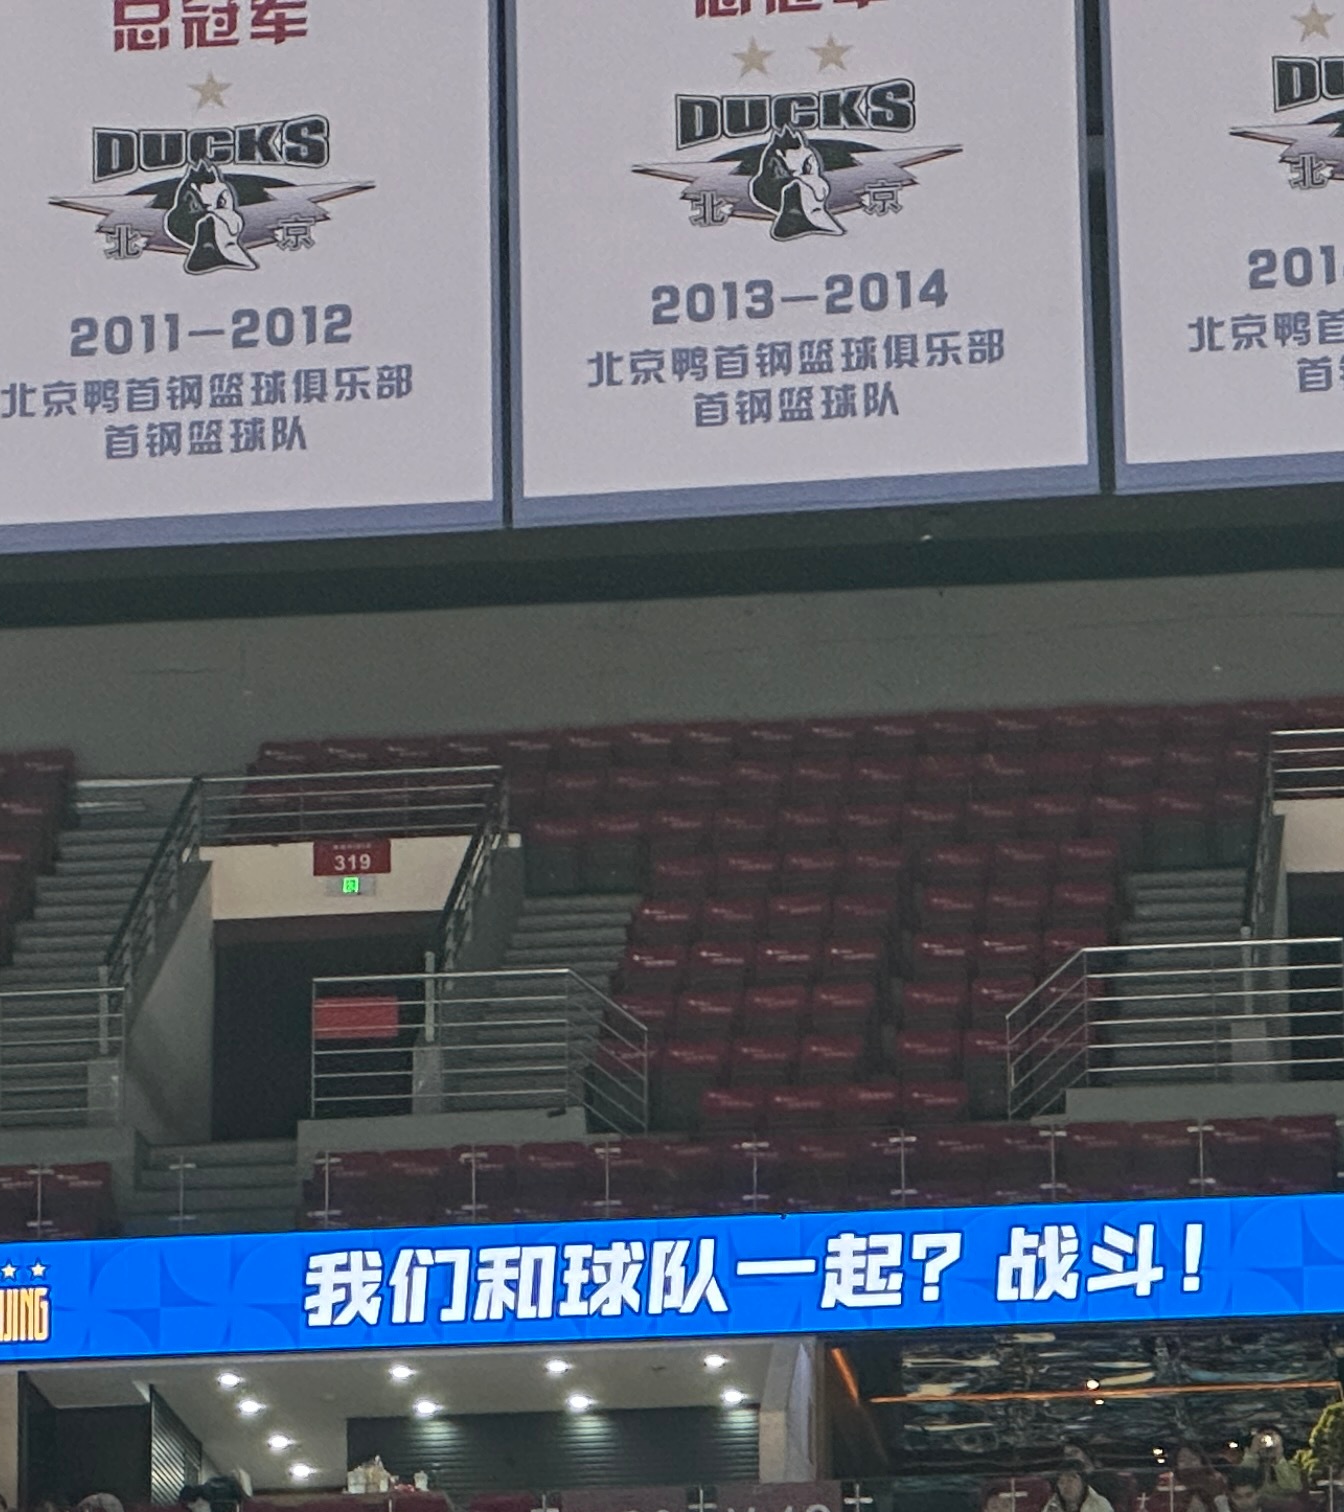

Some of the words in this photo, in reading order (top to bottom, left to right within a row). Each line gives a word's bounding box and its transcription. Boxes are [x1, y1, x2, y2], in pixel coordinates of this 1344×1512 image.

[675, 77, 915, 150] DUCKS
[92, 115, 329, 181] DUCKS
[1289, 153, 1329, 191] 北
[690, 191, 731, 227] 北
[864, 179, 904, 215] 京
[105, 225, 143, 260] 北
[278, 214, 316, 251] 京
[587, 328, 1005, 388] 北京鸭首钢篮球俱乐部
[0, 363, 413, 418] 北京鸭首钢篮球俱乐部
[694, 382, 898, 428] 首钢篮球队
[105, 416, 307, 461] 首钢篮球队
[334, 853, 372, 871] 319
